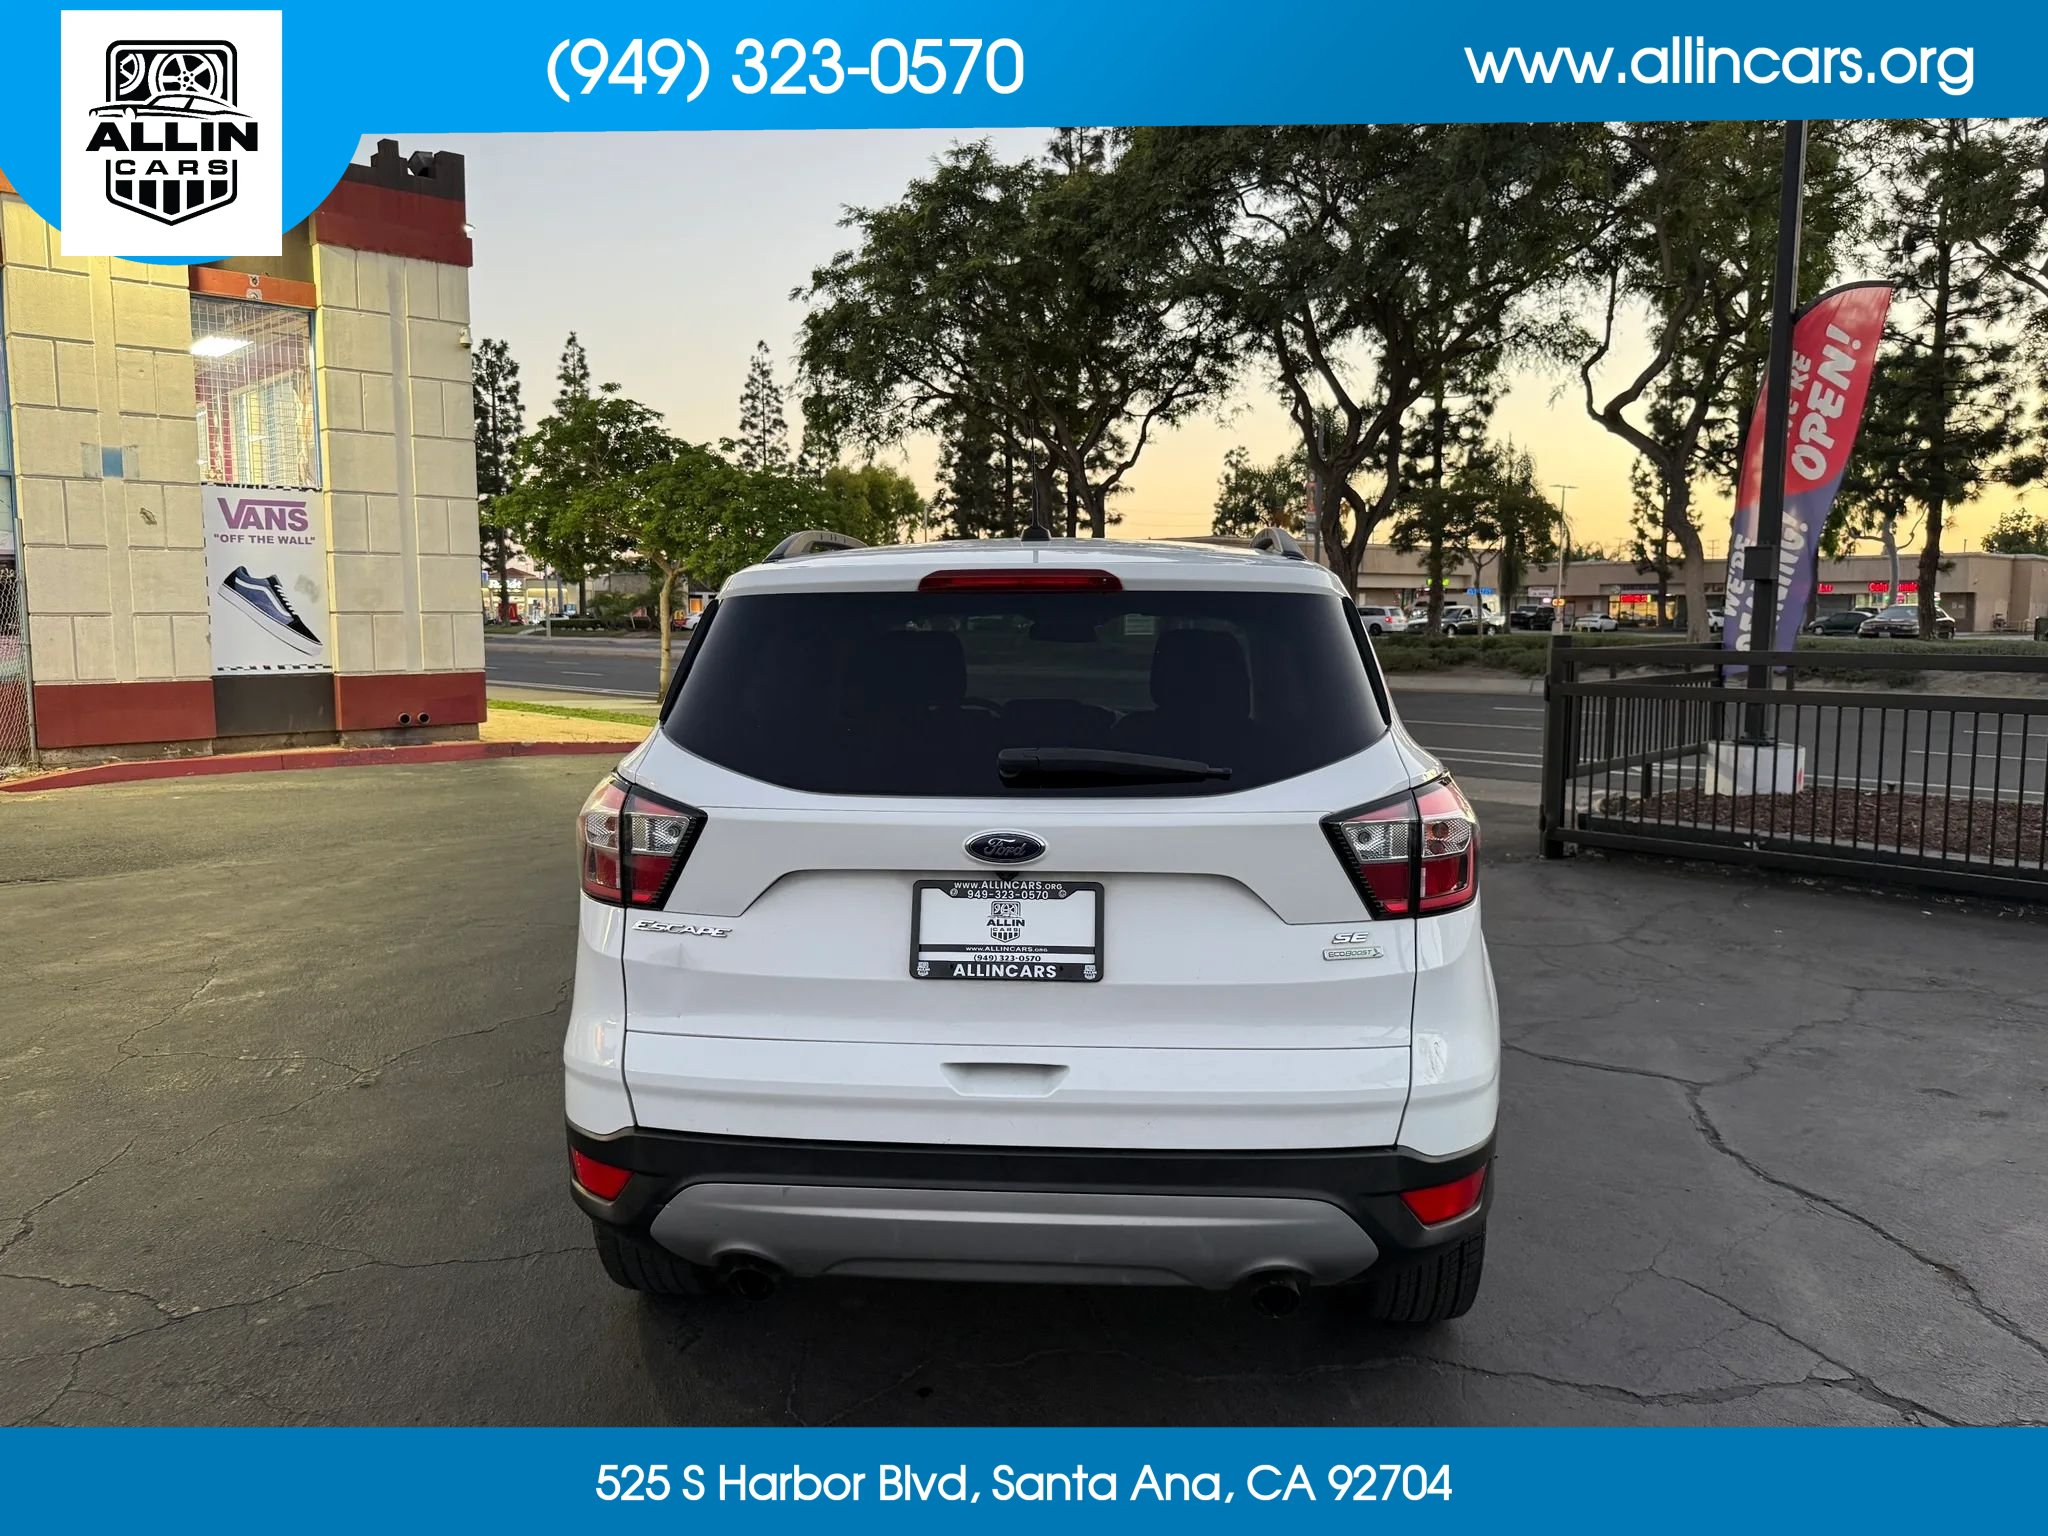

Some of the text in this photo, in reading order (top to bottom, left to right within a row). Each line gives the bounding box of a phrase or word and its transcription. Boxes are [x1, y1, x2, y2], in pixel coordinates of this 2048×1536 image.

[1791, 323, 1862, 480] OPEN!
[217, 497, 309, 532] VANS
[249, 535, 274, 544] THE
[983, 837, 1027, 857] Ford
[967, 889, 1049, 899] 949-323-0570
[632, 919, 733, 938] ESCAPE
[986, 919, 1026, 927] ALLIN
[1332, 932, 1369, 944] SE
[973, 954, 998, 962] (949)
[953, 964, 1057, 979] ALLINCARS
